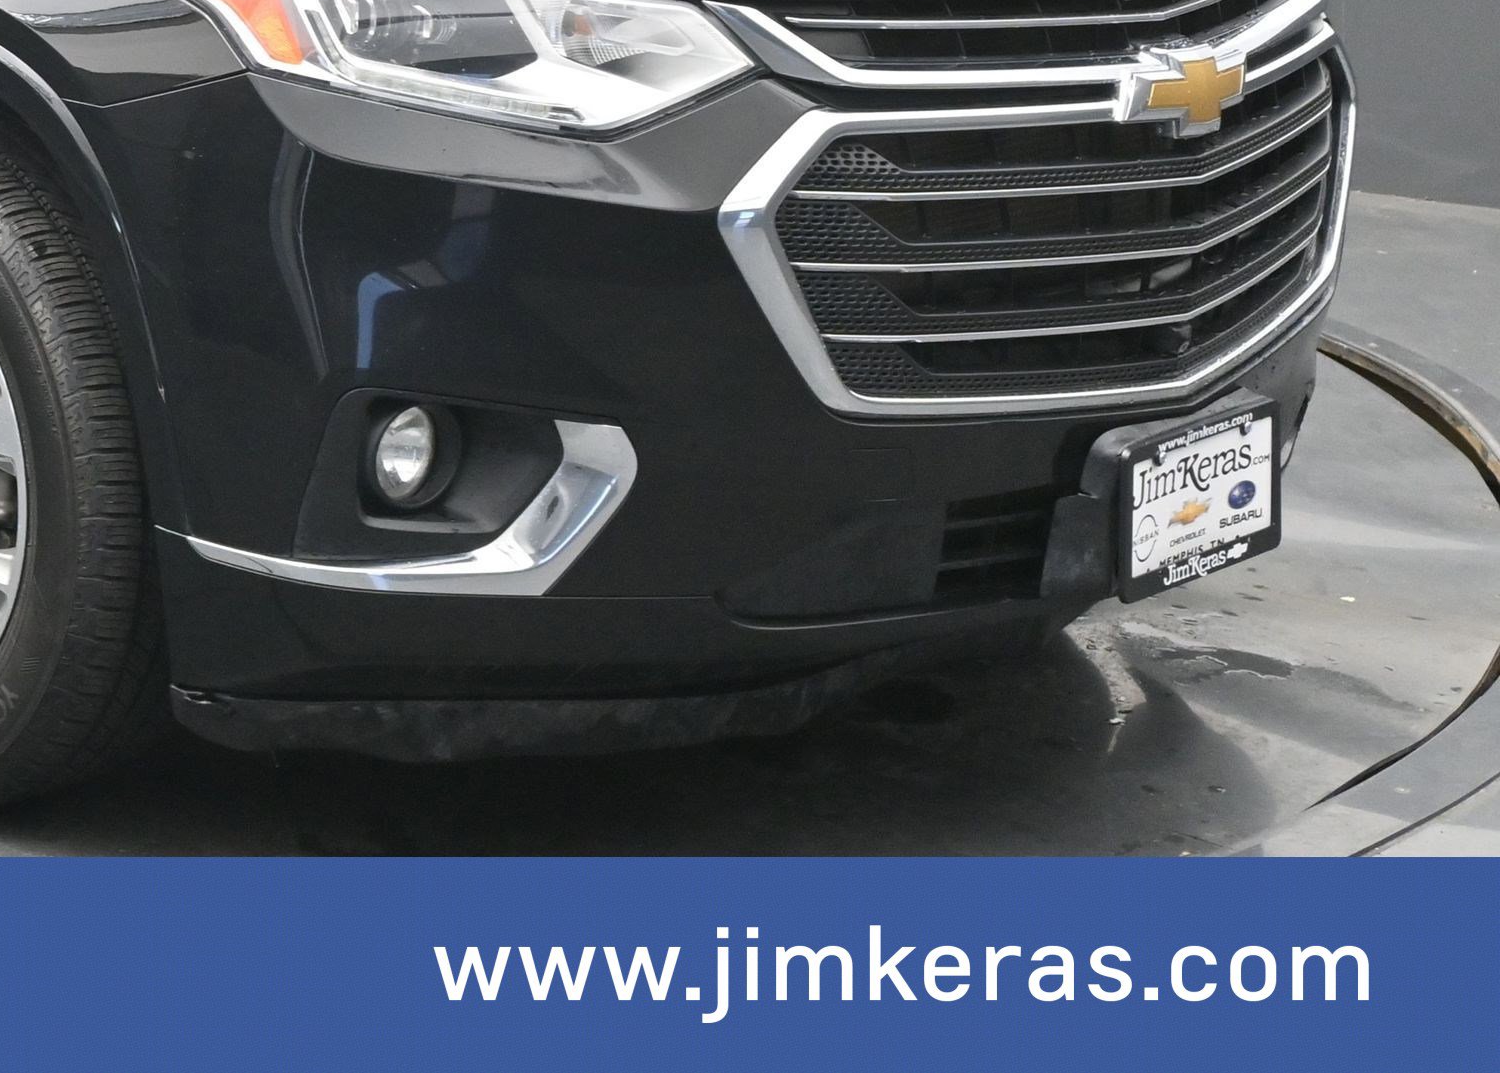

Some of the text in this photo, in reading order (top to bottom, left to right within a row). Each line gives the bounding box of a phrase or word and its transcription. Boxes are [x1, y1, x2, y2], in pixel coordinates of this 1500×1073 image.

[1158, 412, 1253, 453] www.jimkeras.com
[1219, 508, 1263, 529] SUBARU
[1133, 529, 1159, 546] NISSAN
[1169, 528, 1206, 547] CHEVROLET
[1159, 538, 1225, 568] MEMPHIS TN
